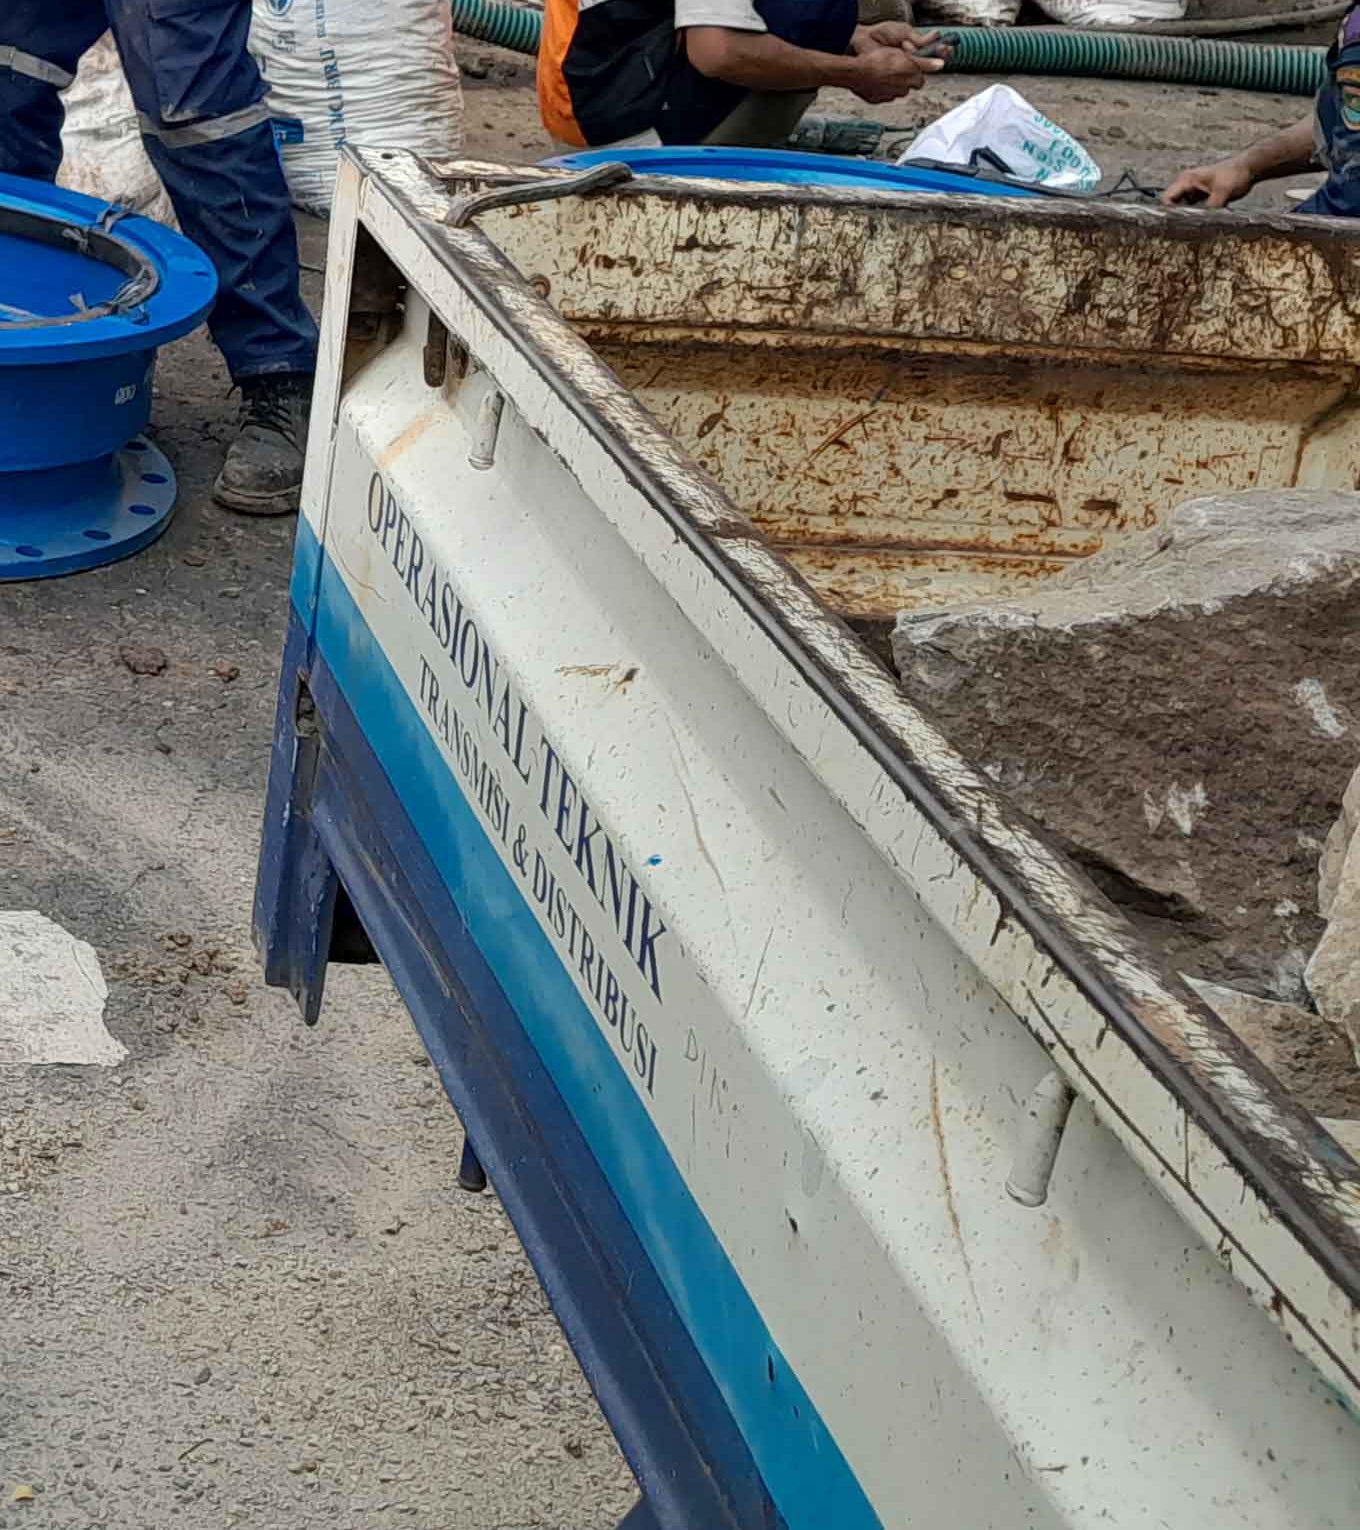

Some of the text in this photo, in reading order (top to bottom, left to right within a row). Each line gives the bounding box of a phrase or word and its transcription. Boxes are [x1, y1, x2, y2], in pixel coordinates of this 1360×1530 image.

[367, 471, 668, 1006] OPERASIONAL TEKNIK
[418, 654, 660, 1101] TRANSMISI & DISTRIBUSI
